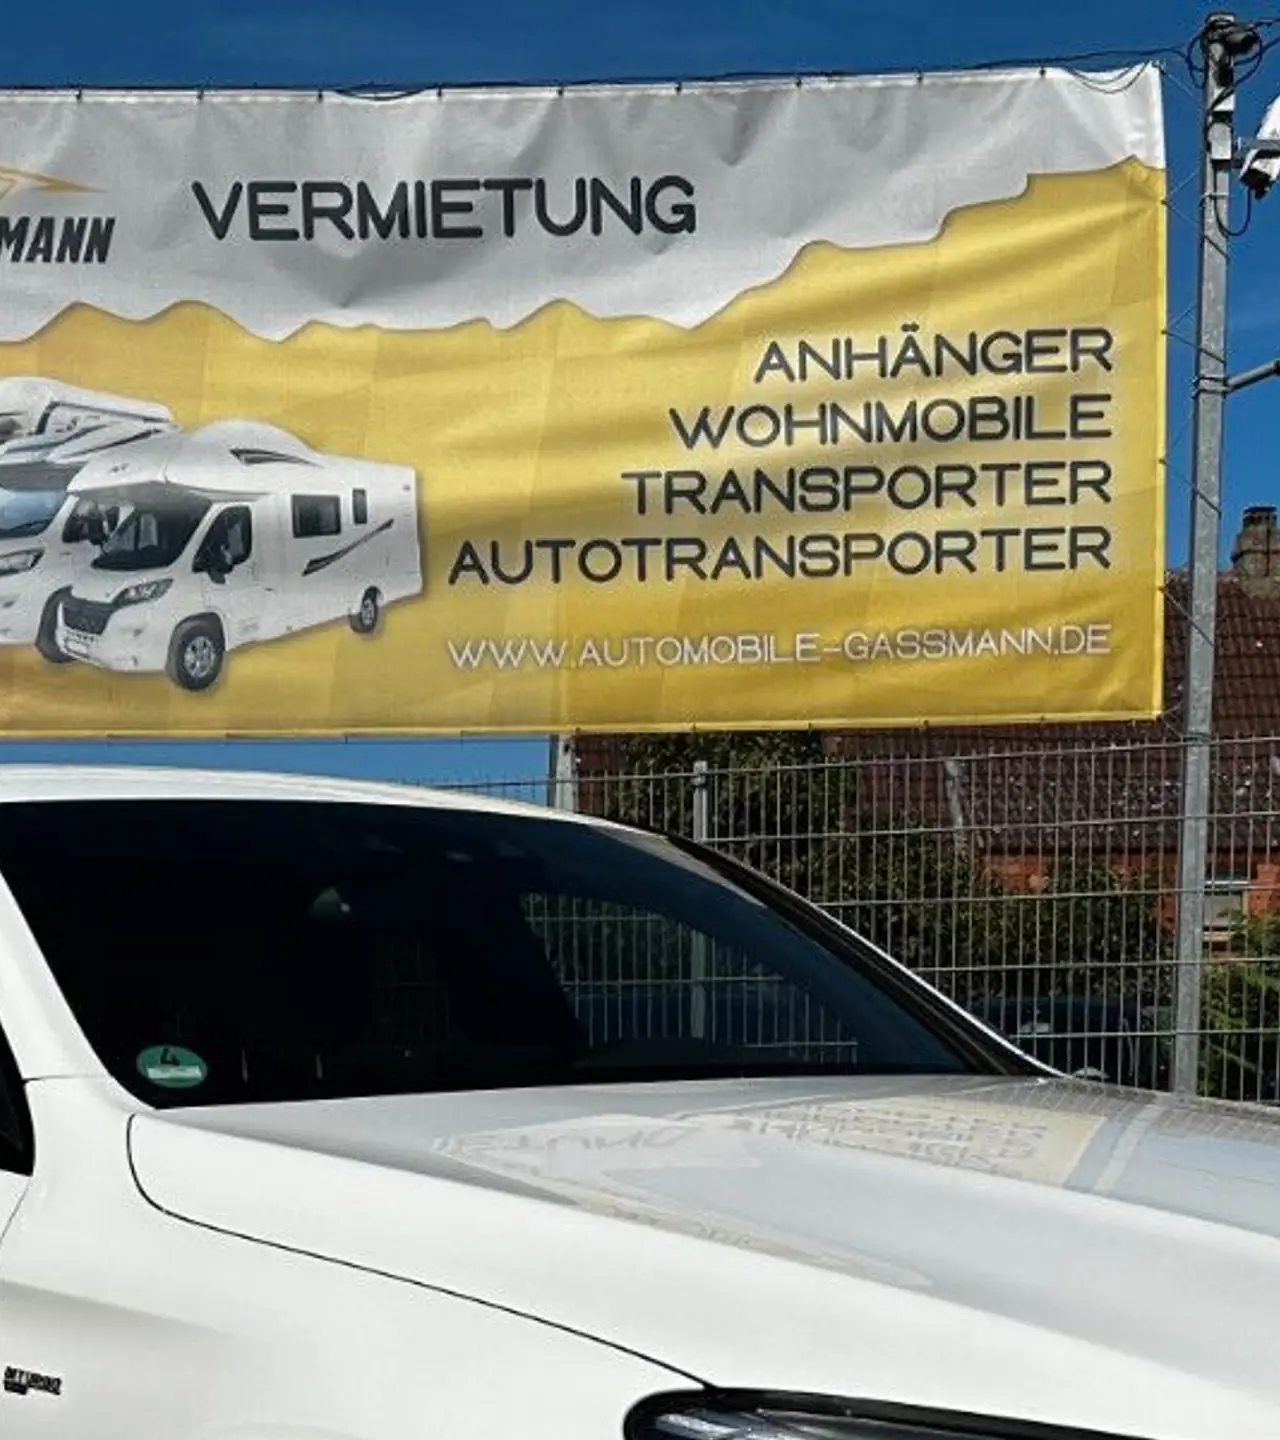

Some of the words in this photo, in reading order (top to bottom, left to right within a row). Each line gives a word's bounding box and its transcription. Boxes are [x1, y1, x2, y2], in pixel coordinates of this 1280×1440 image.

[191, 175, 696, 241] VERMIETUNG
[754, 323, 1113, 383] ANHÄNGER
[668, 393, 1113, 450] WOHNMOBILE
[621, 459, 1112, 516] TRANSPORTER
[447, 525, 1112, 586] AUTOTRANSPORTER
[447, 623, 1112, 669] WWW.AUTOMOBILE-GASSMANN.DE
